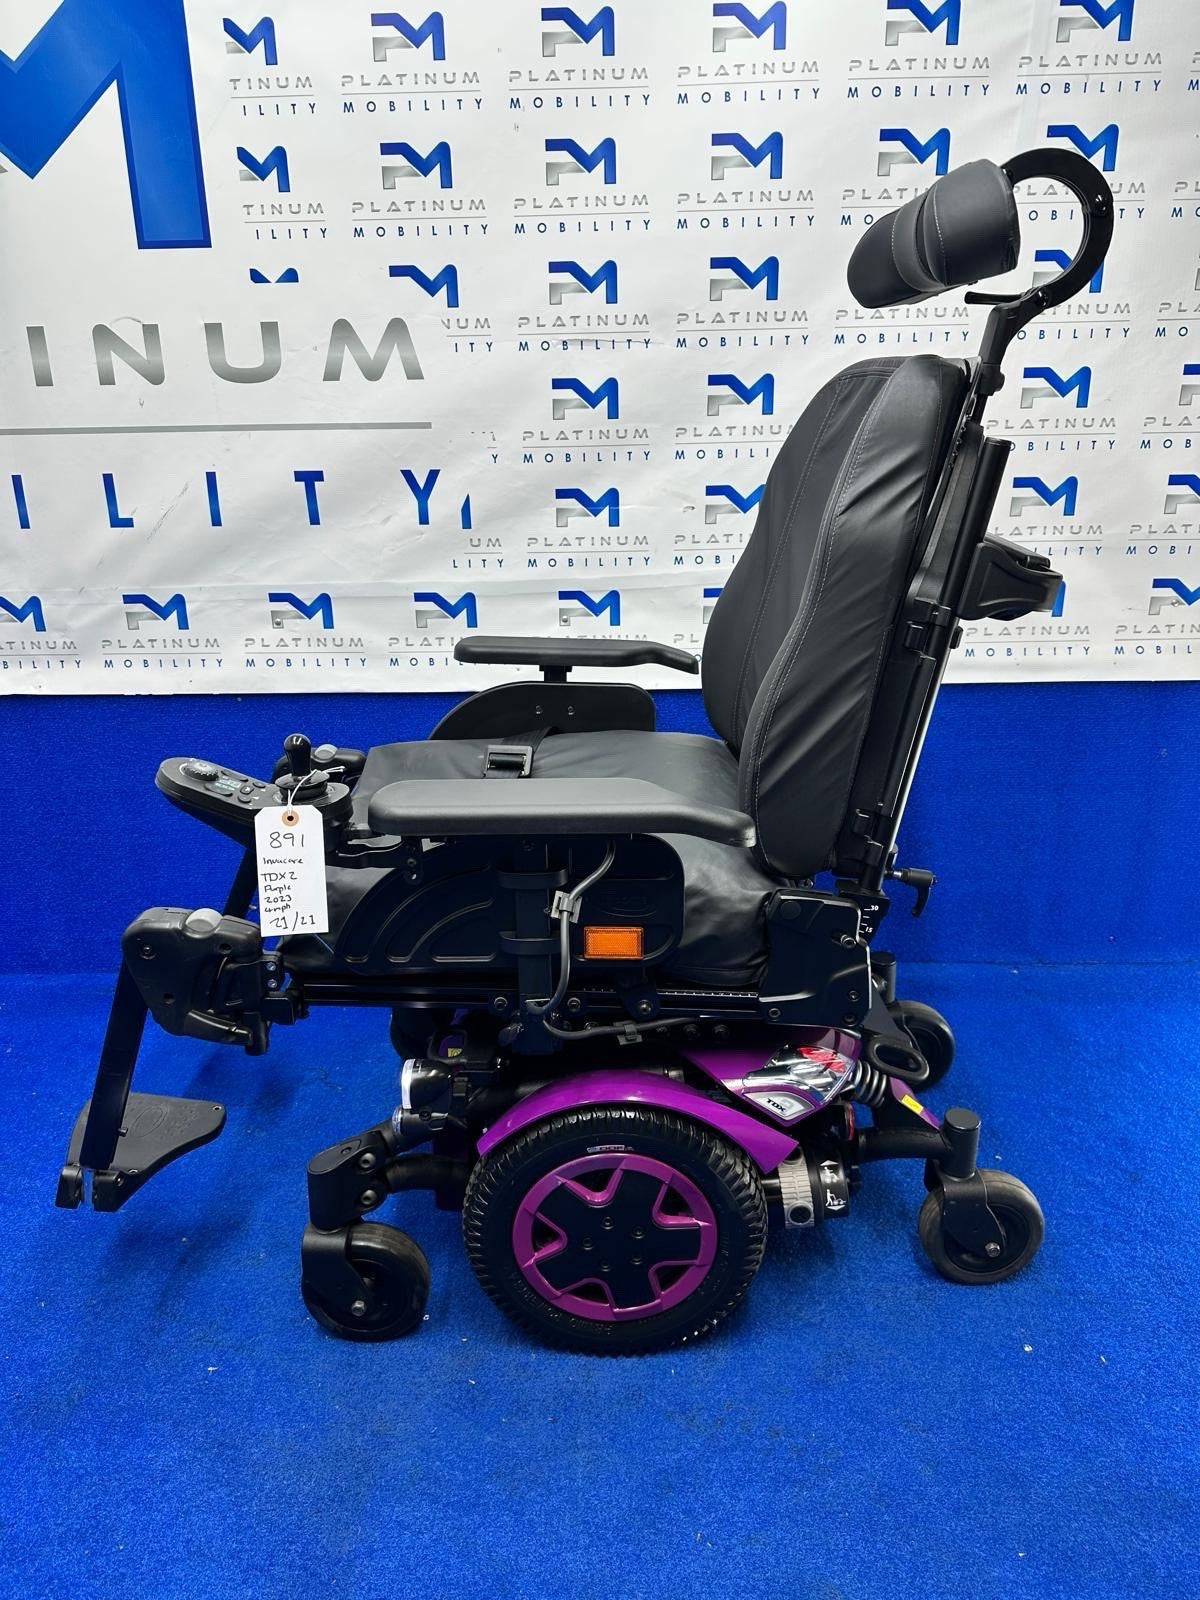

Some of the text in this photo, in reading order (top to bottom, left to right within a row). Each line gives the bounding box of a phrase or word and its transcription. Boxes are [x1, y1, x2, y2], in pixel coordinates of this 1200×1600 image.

[849, 57, 989, 71] PLATINUM
[1019, 53, 1161, 68] PLATINUM
[509, 68, 648, 82] PLATINUM
[678, 61, 818, 78] PLATINUM
[342, 72, 479, 87] PLATINUM
[1016, 78, 1161, 95] MOBILITY
[677, 88, 819, 104] MOBILITY
[847, 84, 989, 98] MOBILITY
[344, 98, 482, 113] MOBILITY
[510, 94, 650, 109] MOBILITY
[514, 195, 648, 209] PLATINUM
[678, 190, 813, 204] PLATINUM
[352, 199, 485, 213] PLATINUM
[515, 219, 650, 234] MOBILITY
[677, 216, 814, 229] MOBILITY
[354, 224, 488, 237] MOBILITY
[677, 311, 808, 324] PLATINUM
[835, 306, 969, 321] PLATINUM
[518, 314, 649, 328] PLATINUM
[676, 335, 808, 348] MOBILITY
[834, 331, 969, 344] MOBILITY
[518, 338, 650, 352] MOBILITY
[986, 417, 1116, 430] PLATINUM
[523, 428, 648, 441] PLATINUM
[523, 451, 650, 463] MOBILITY
[528, 536, 648, 546] PLATINUM
[528, 557, 650, 567] MOBILITY
[966, 626, 1089, 636] PLATINUM
[102, 638, 220, 648] PLATINUM
[245, 638, 363, 647] PLATINUM
[965, 646, 1090, 657] MOBILITY
[104, 659, 222, 668] MOBILITY
[246, 658, 366, 667] MOBILITY
[270, 831, 304, 848] 891
[264, 895, 292, 904] 2023
